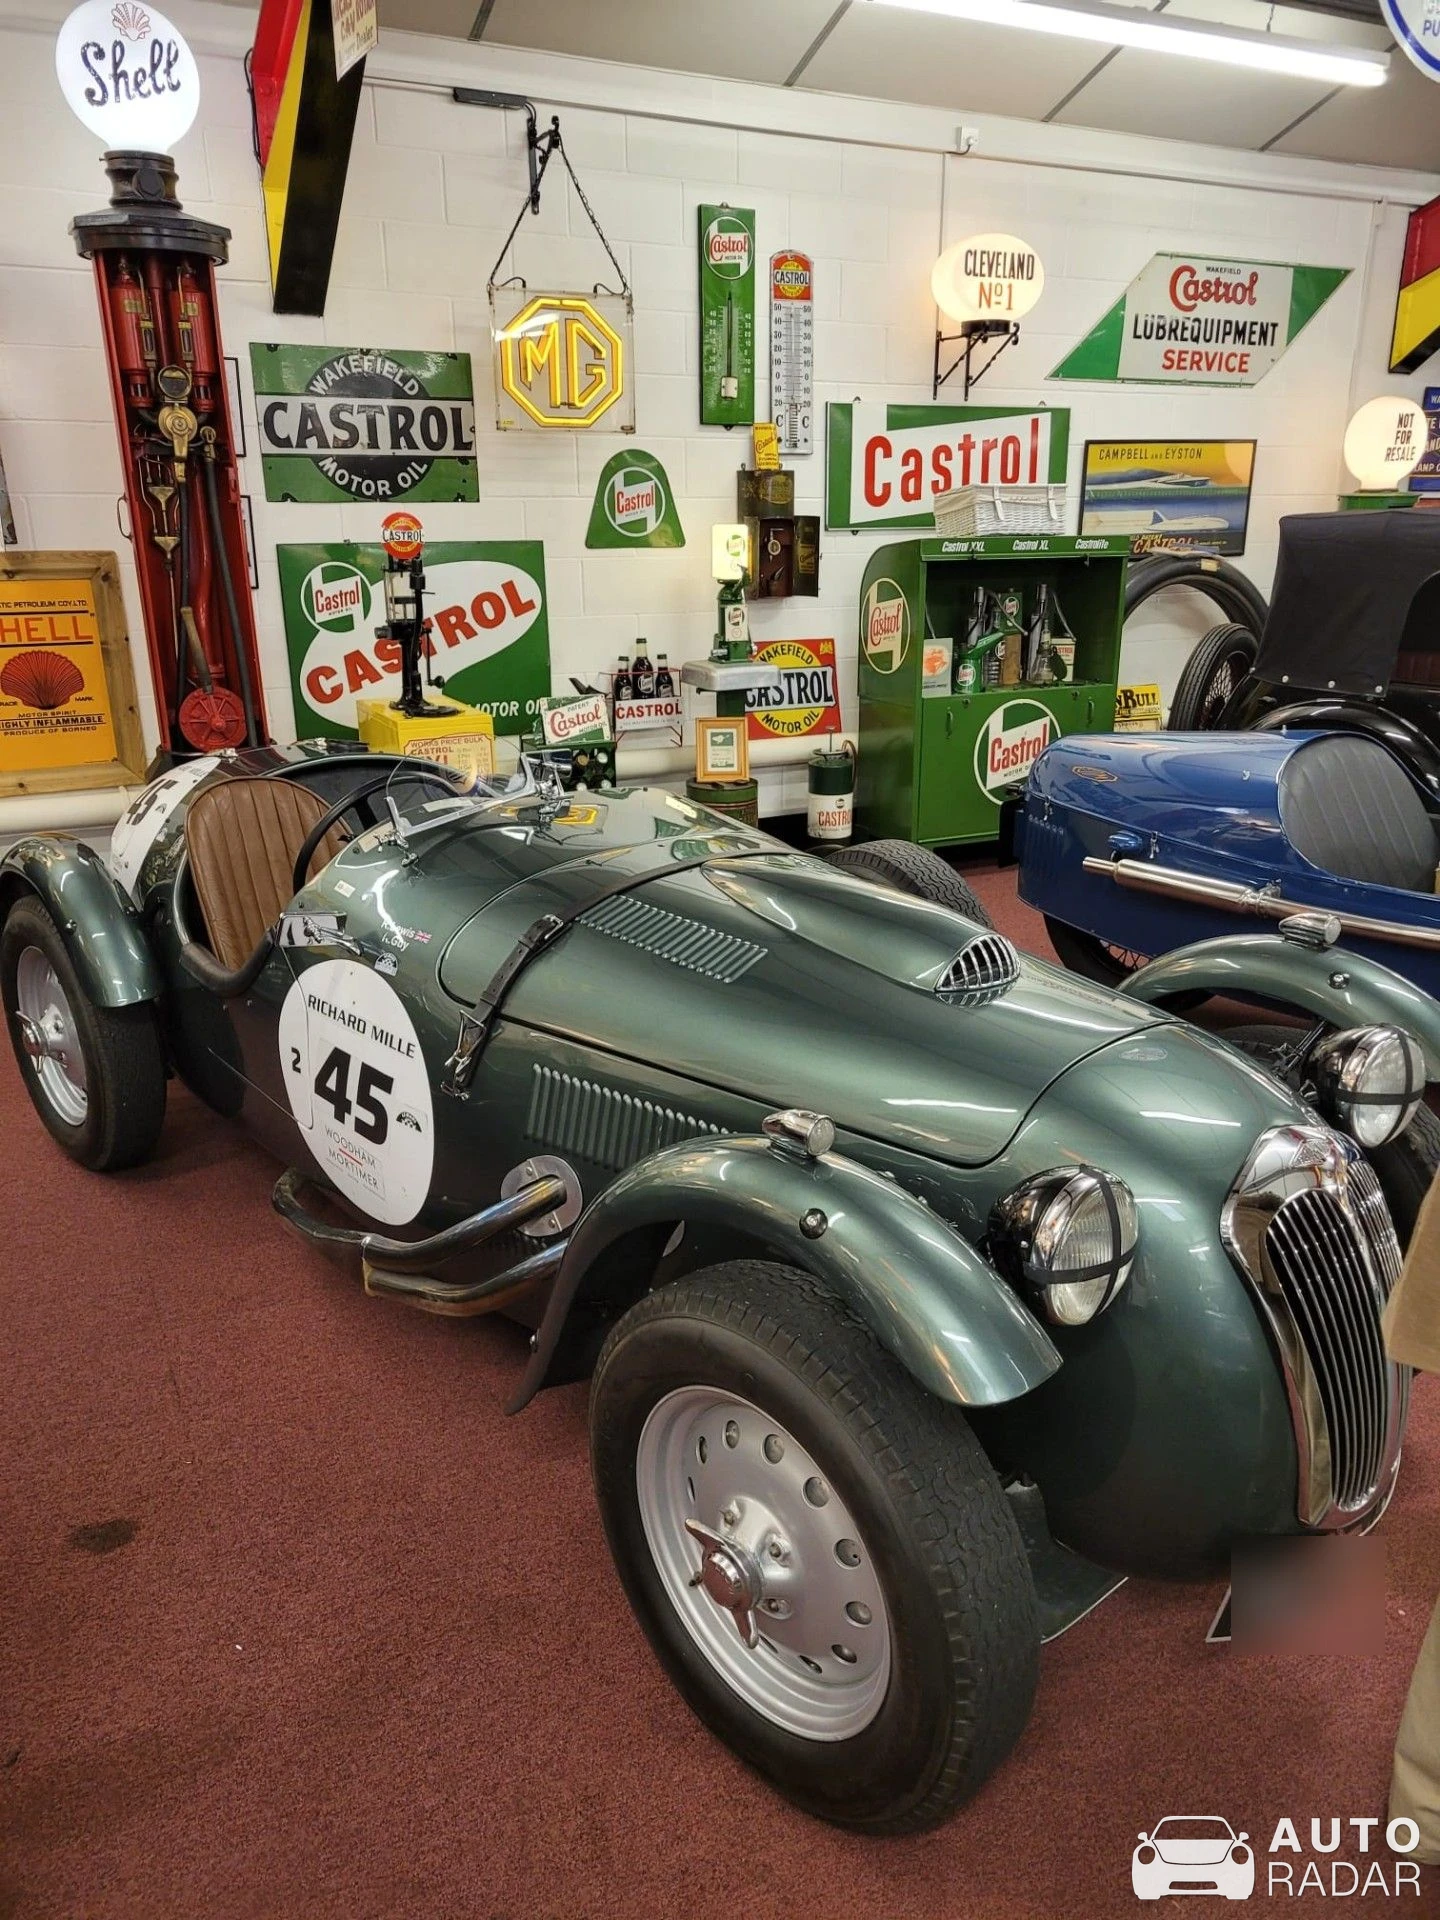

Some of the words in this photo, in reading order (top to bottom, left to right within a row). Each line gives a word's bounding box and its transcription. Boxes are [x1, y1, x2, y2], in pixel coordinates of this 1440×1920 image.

[81, 38, 181, 107] Shell
[710, 234, 748, 262] Castrol
[775, 270, 809, 285] CASTROL
[964, 249, 1035, 280] CLEVELAND
[1206, 265, 1242, 275] WAKEFIELD
[1169, 264, 1259, 312] Castrol
[1133, 313, 1279, 346] LUBREQUIPMENT
[518, 318, 607, 409] MG
[1162, 348, 1251, 373] SERVICE
[309, 356, 419, 396] WAKEFIELD
[263, 401, 474, 451] CASTROL
[776, 414, 783, 427] C
[802, 415, 809, 428] C
[1397, 413, 1415, 428] NOT
[1395, 430, 1413, 445] FOR
[864, 418, 1039, 507] Castrol
[1099, 448, 1148, 460] CAMPBELL
[1165, 448, 1202, 459] EYSTON
[1385, 446, 1416, 461] RESALE
[318, 456, 392, 496] MOTOR
[397, 461, 428, 489] OIL
[617, 484, 654, 513] Castrol
[383, 528, 424, 544] CASTROL
[942, 541, 968, 552] Castrol
[970, 541, 985, 552] XXL
[1012, 540, 1038, 550] Castrol
[1039, 540, 1049, 550] XL
[14, 599, 55, 608] PETROLEUM
[315, 581, 360, 613] Castrol
[871, 602, 902, 646] Castrol
[33, 715, 104, 727] INFLAMMABLE
[51, 709, 77, 717] SPIRIT
[550, 703, 602, 737] Castrol
[616, 702, 683, 720] CASTROL
[762, 713, 802, 733] MOTOR
[803, 710, 820, 727] OIL
[62, 725, 97, 733] BORNEO
[410, 740, 439, 748] WORKS
[440, 738, 463, 746] PRICE
[464, 735, 484, 744] BULK
[410, 746, 454, 756] CASTROL
[990, 723, 1048, 773] Castrol
[308, 994, 367, 1034] RICHARD
[371, 1025, 416, 1058] MILLE
[291, 1046, 301, 1073] 2
[314, 1046, 394, 1146] 45
[324, 1124, 377, 1169] WOODHAM
[328, 1146, 380, 1190] MORTIMER
